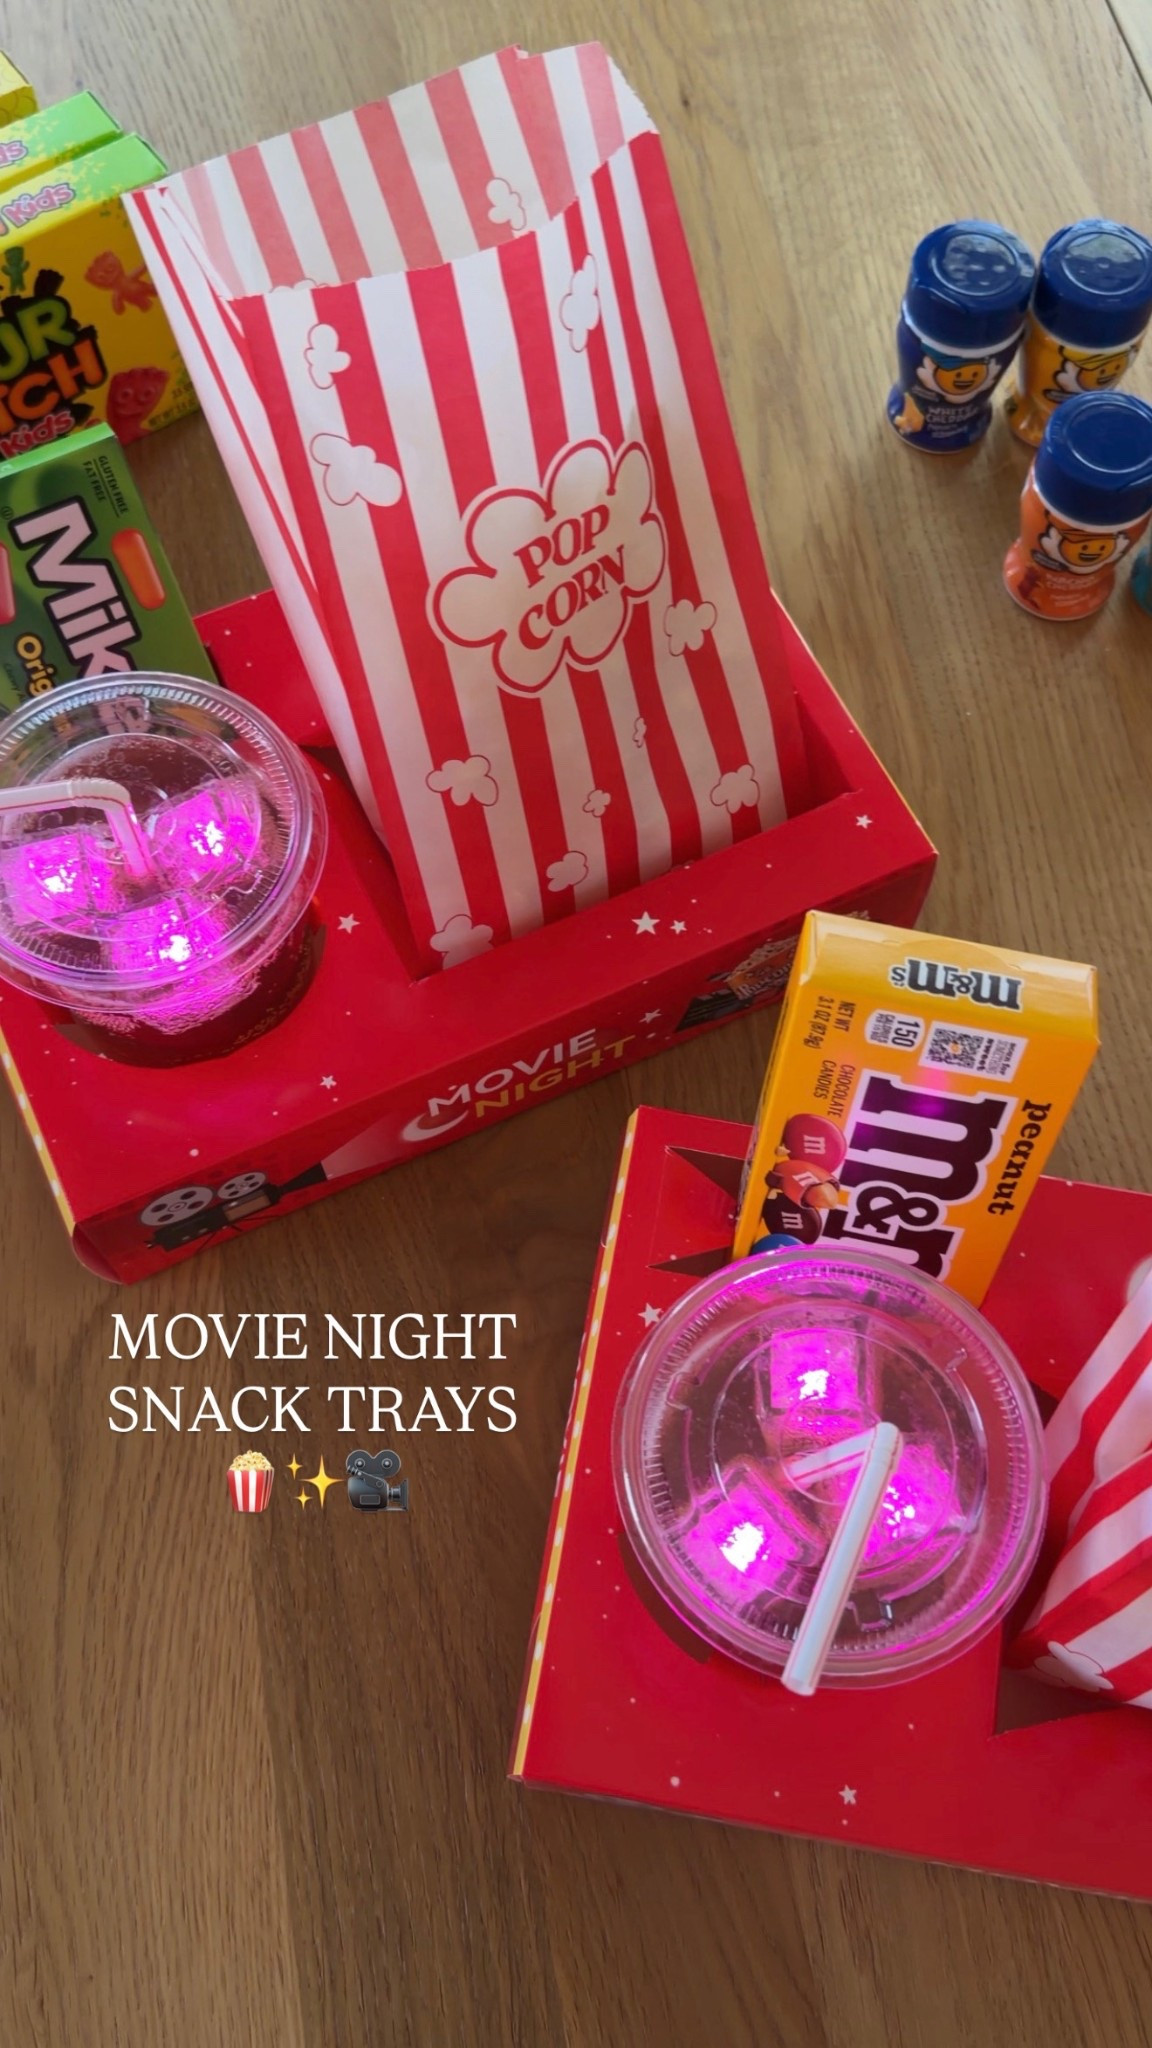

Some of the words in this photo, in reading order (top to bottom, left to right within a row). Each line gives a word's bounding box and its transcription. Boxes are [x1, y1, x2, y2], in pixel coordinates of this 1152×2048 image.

[2, 183, 76, 228] Kids
[82, 460, 97, 478] FAT
[91, 479, 106, 502] FREE
[98, 455, 119, 490] GLUTEN
[112, 491, 129, 514] FREE
[513, 504, 610, 589] POP
[518, 544, 625, 650] CORN
[813, 1010, 831, 1022] OZ
[817, 995, 834, 1010] 3.1
[838, 1000, 856, 1018] NET
[803, 1020, 827, 1050] (87.9g)
[833, 1018, 851, 1032] WT
[891, 1020, 921, 1048] 150
[428, 1028, 597, 1118] MOVIE
[475, 1034, 636, 1119] NIGHT
[813, 1060, 837, 1099] CANDIES
[827, 1064, 856, 1118] CHOCOLATE
[987, 1099, 1052, 1216] peanut
